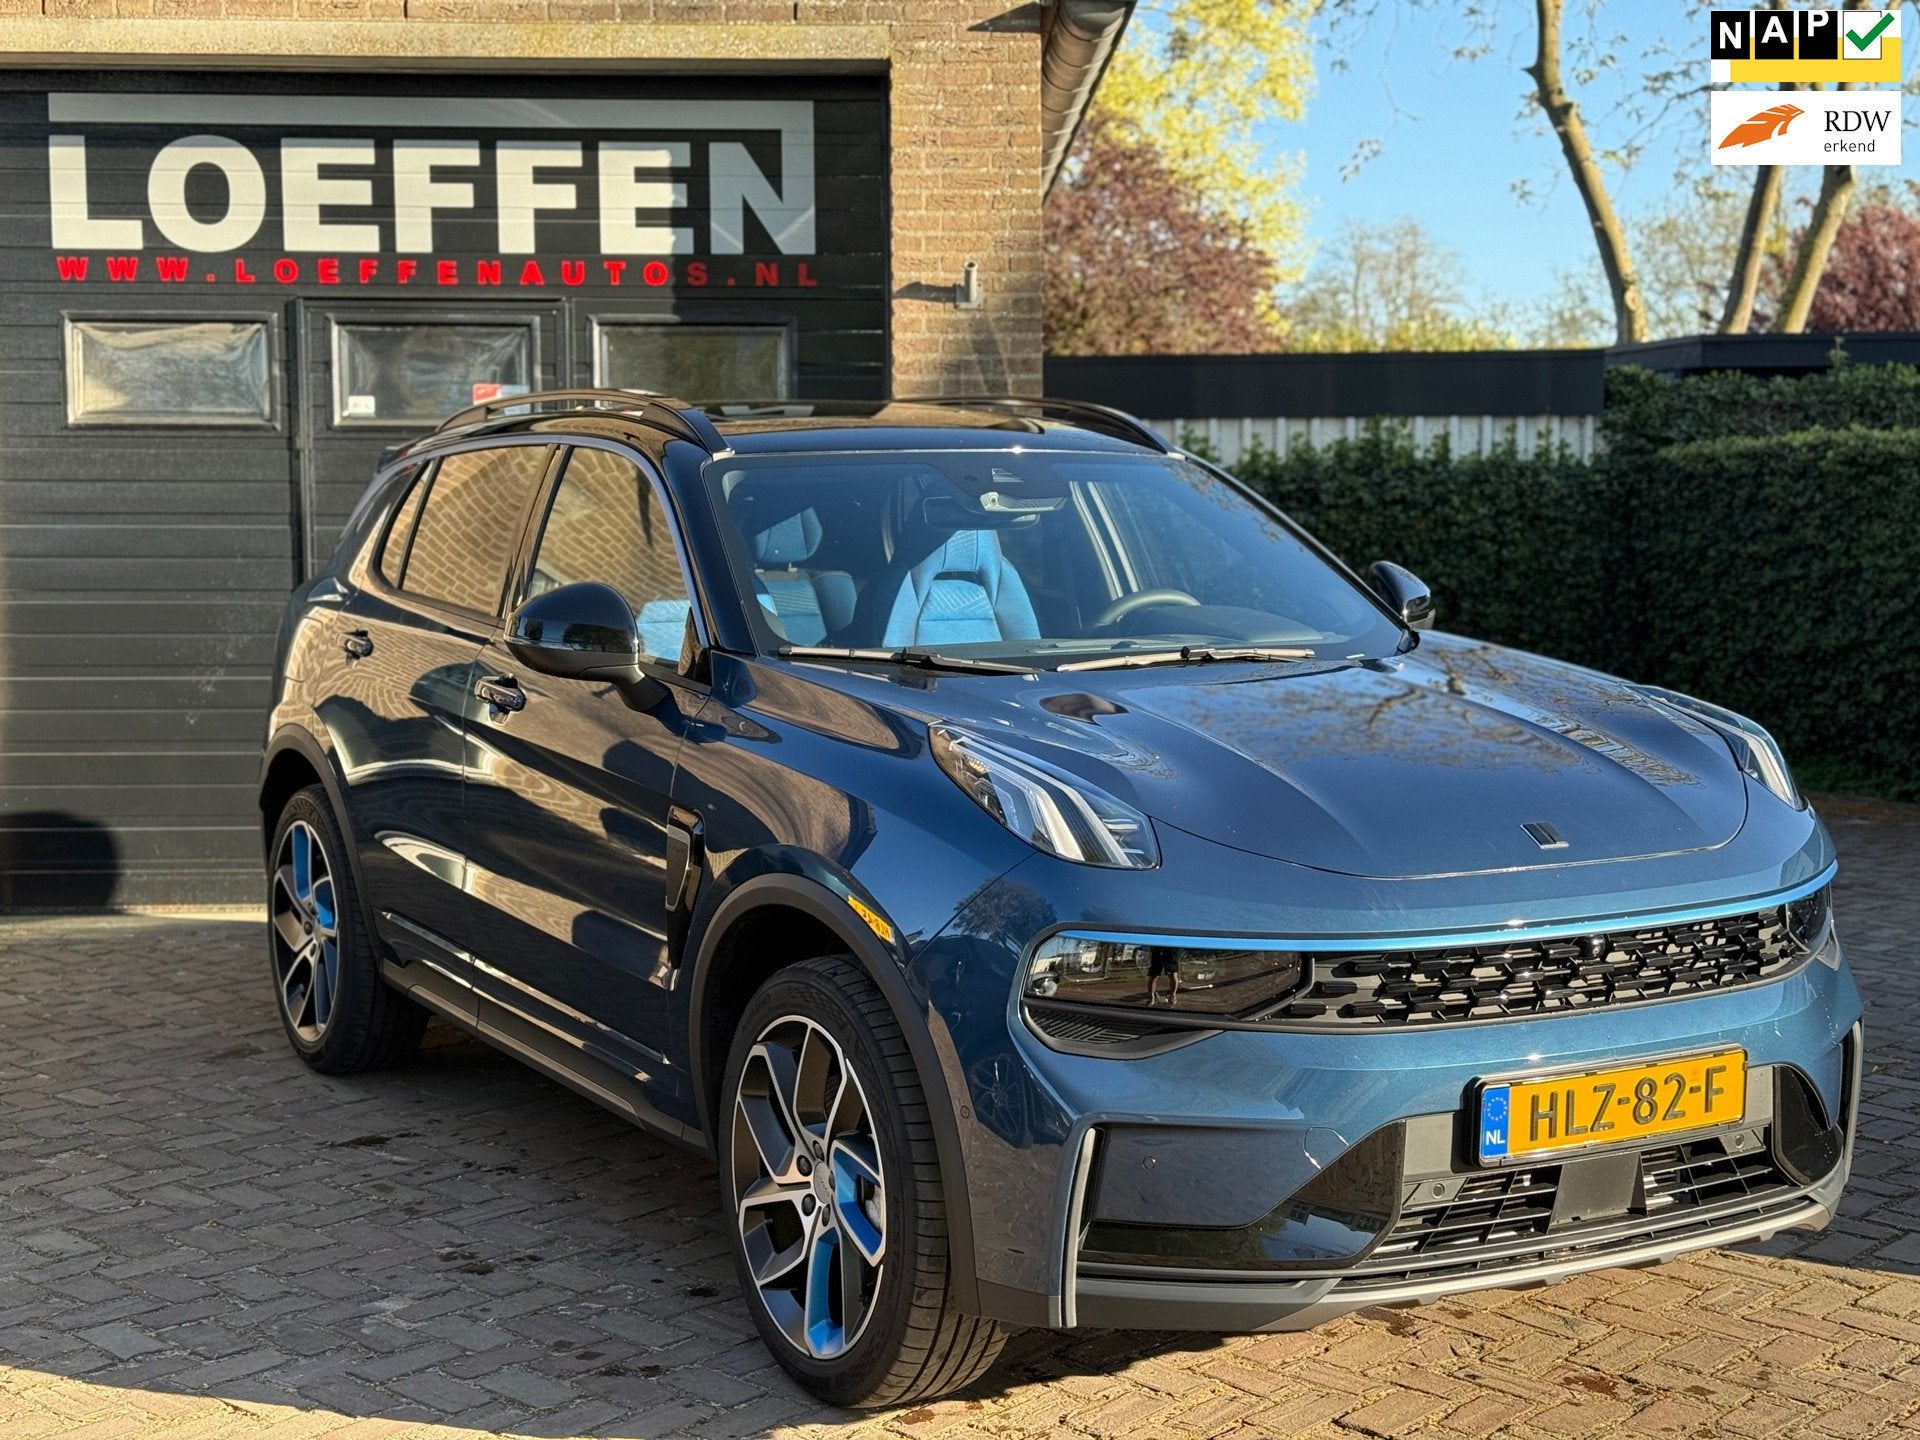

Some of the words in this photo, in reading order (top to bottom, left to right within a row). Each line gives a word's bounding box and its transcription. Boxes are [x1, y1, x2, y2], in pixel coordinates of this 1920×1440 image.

[49, 135, 816, 255] LOEFFEN
[56, 256, 818, 287] WWW.LOEFFENAUTOS.NL
[1529, 1065, 1727, 1141] HLZ-82-F
[1486, 1130, 1505, 1146] NL
